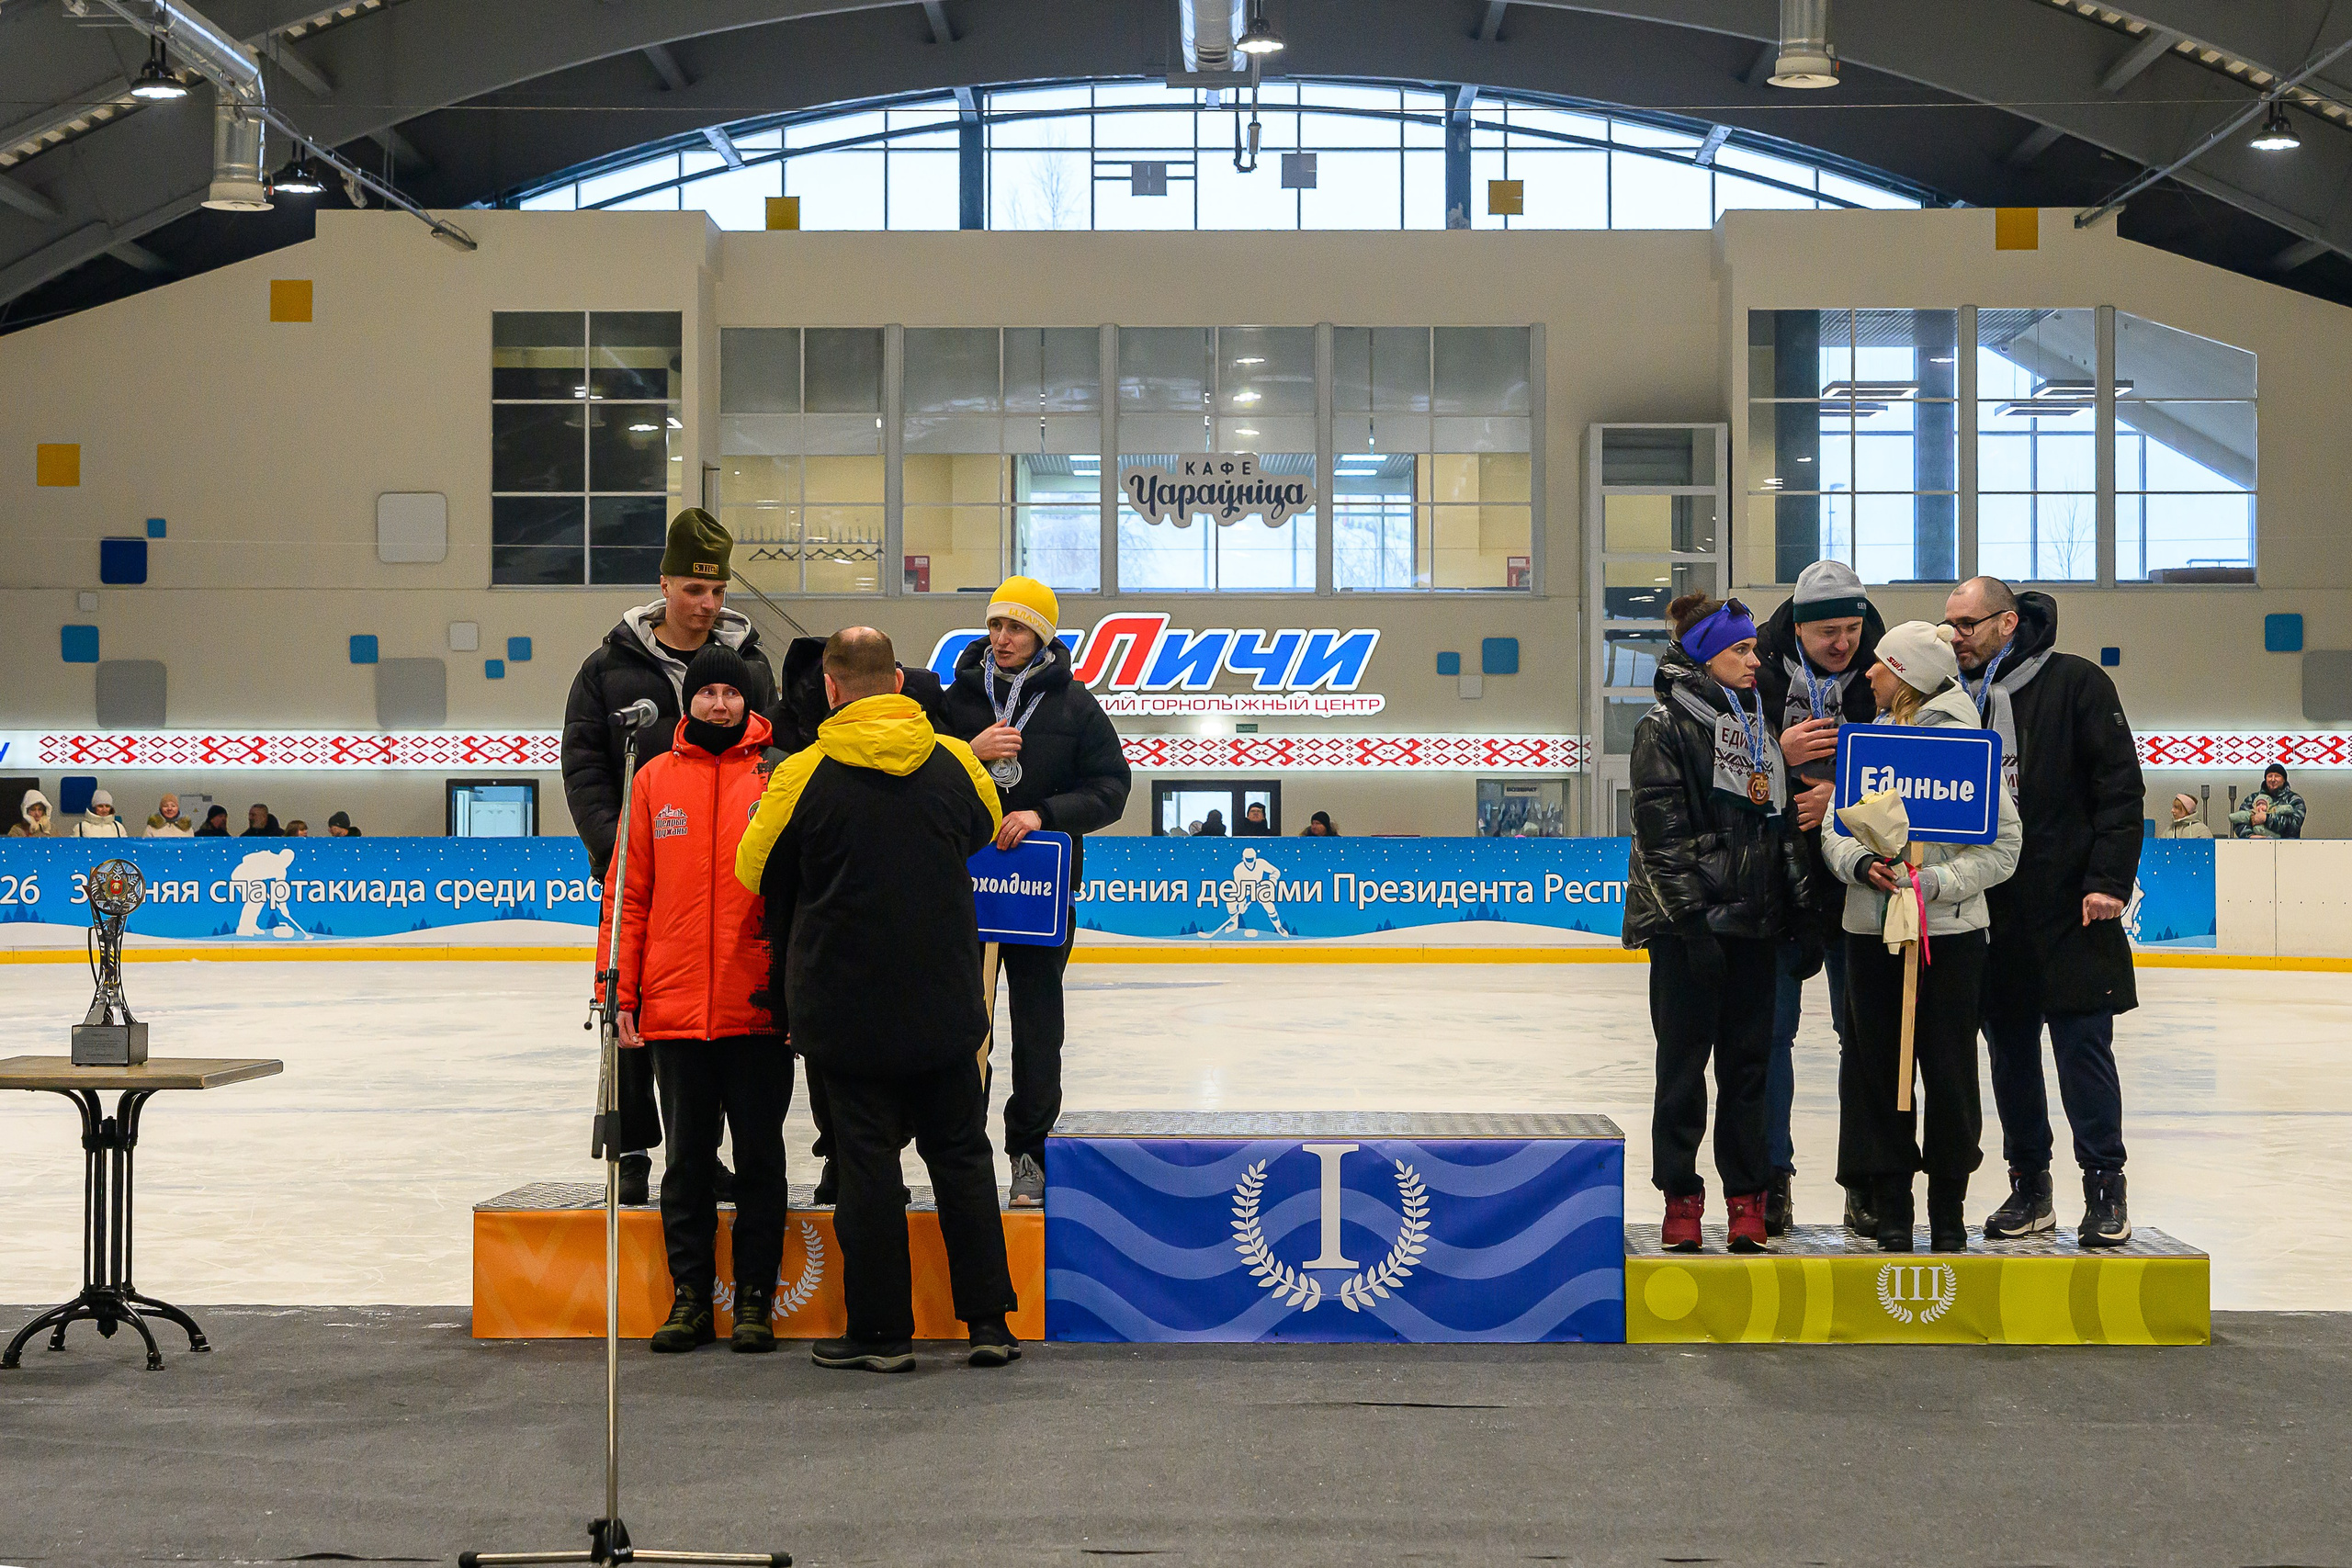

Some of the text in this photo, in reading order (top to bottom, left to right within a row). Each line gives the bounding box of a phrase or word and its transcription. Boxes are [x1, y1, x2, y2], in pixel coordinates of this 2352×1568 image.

[1185, 461, 1252, 476] КАФЕ
[1129, 473, 1308, 520] Чараўніца
[1141, 695, 1309, 711] ГОРНОЛЫЖНЫЙ
[1314, 699, 1381, 714] ЦЕНТР
[1860, 765, 1975, 802] Единые
[209, 879, 425, 909] спартакиада
[435, 879, 536, 909] среди
[1196, 879, 1323, 908] делами
[1332, 873, 1533, 910] Президента
[1302, 1144, 1360, 1269] I
[1890, 1266, 1944, 1302] III
